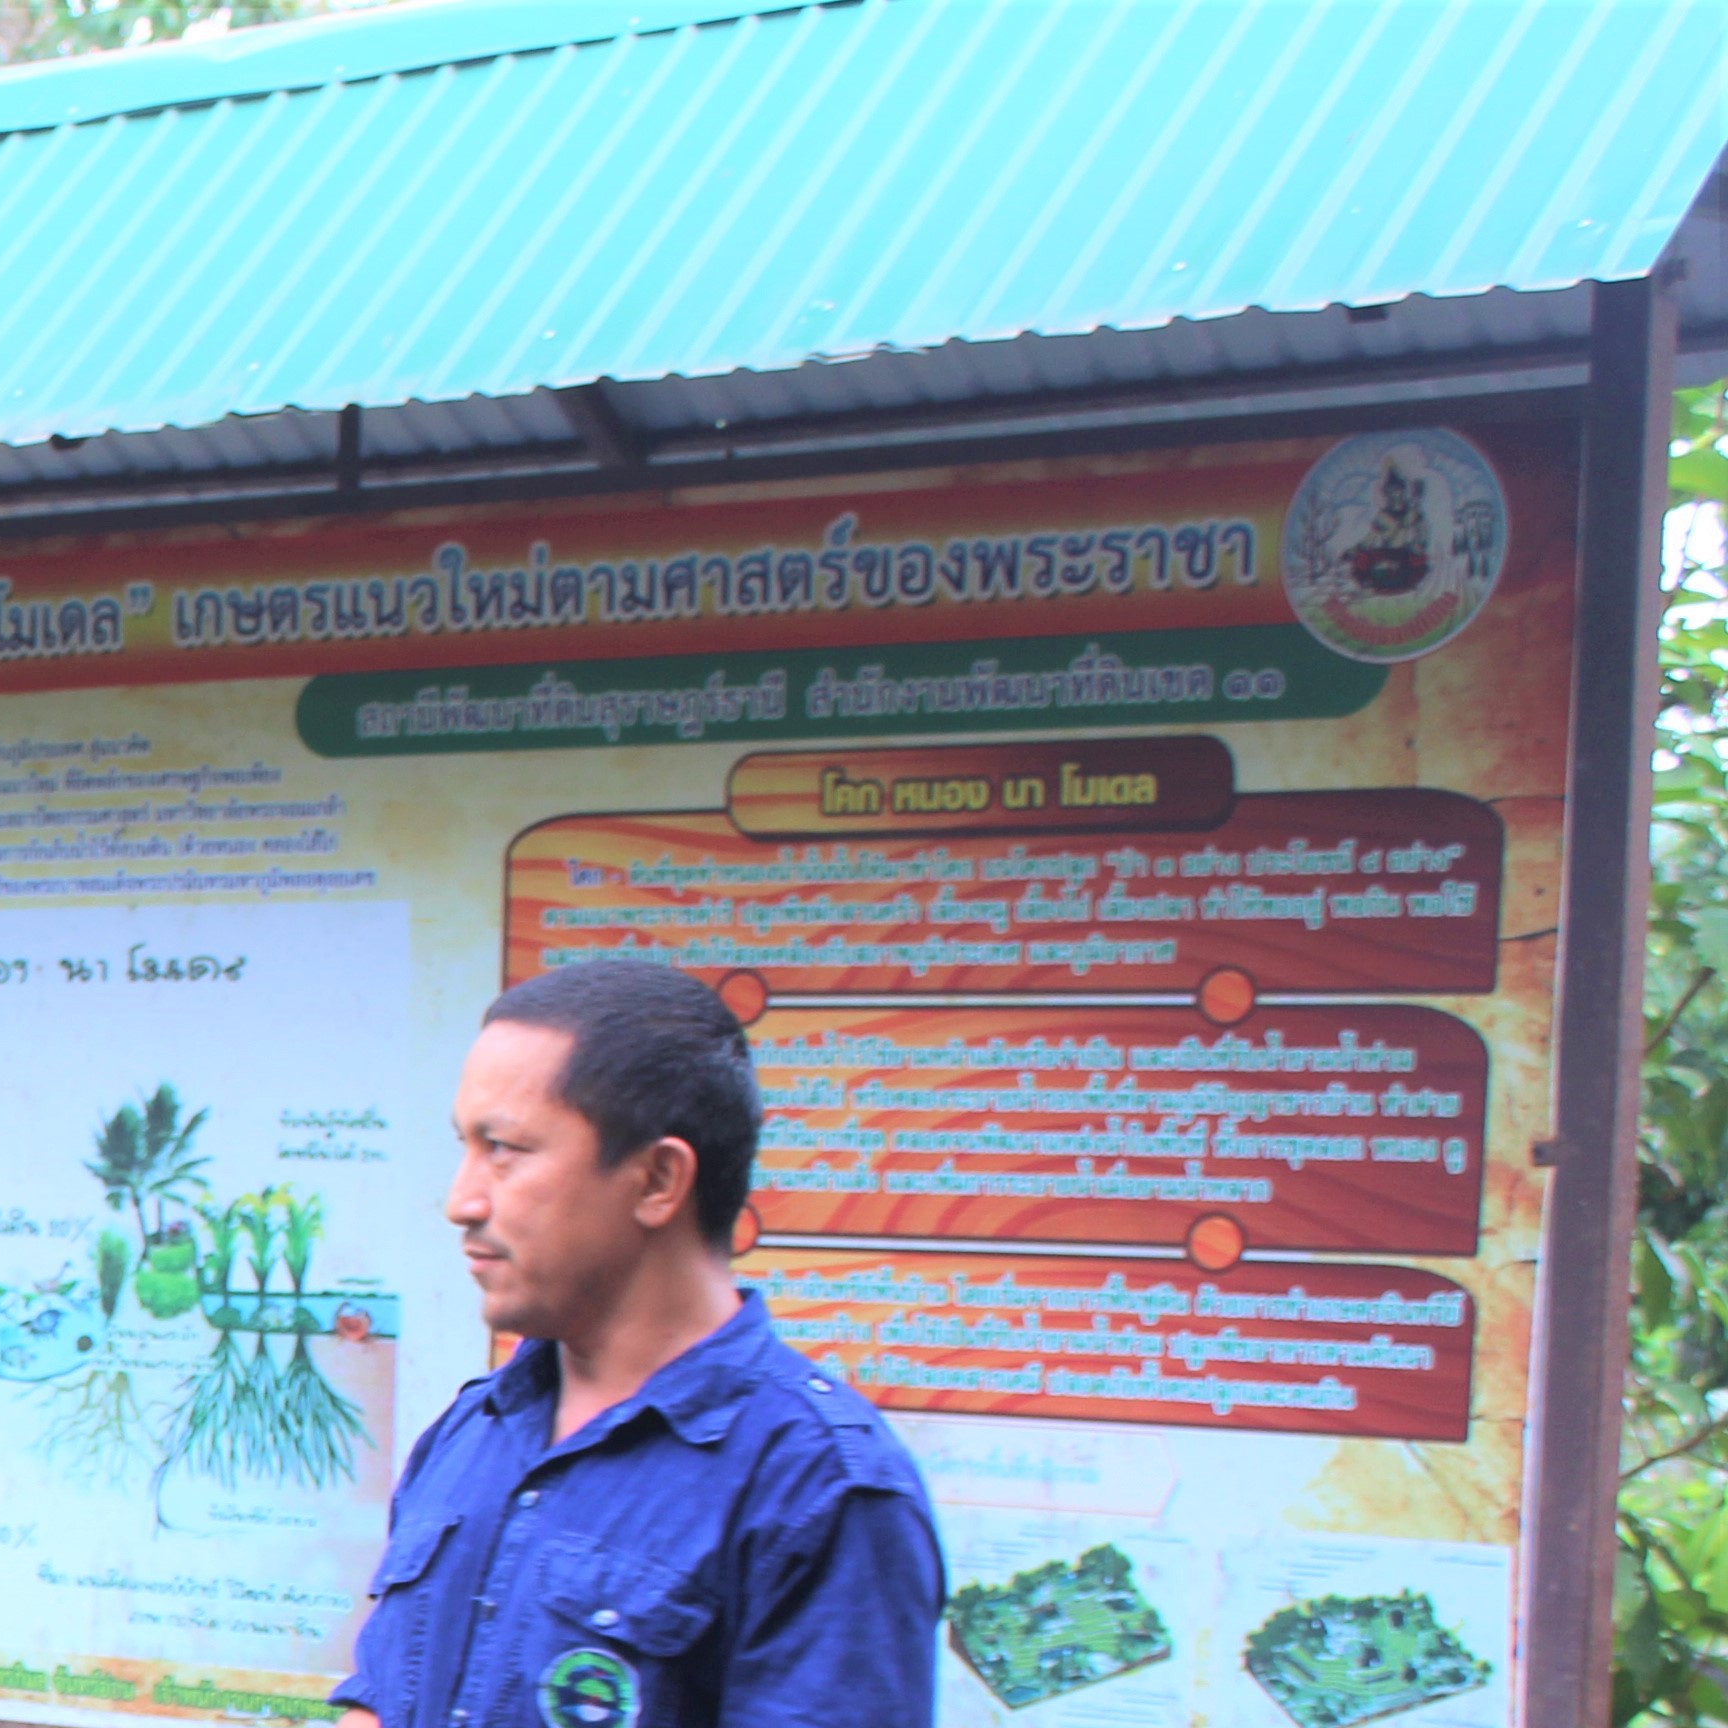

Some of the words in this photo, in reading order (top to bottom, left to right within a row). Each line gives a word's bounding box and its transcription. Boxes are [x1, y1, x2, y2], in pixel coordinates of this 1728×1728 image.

[172, 513, 1256, 648] เกษตรแนวใหม่ตามศาสตร์ของพระราชา
[821, 765, 882, 815] โคก
[894, 778, 990, 813] หนอง
[1003, 775, 1044, 808] นา
[1059, 763, 1158, 806] โมเดล
